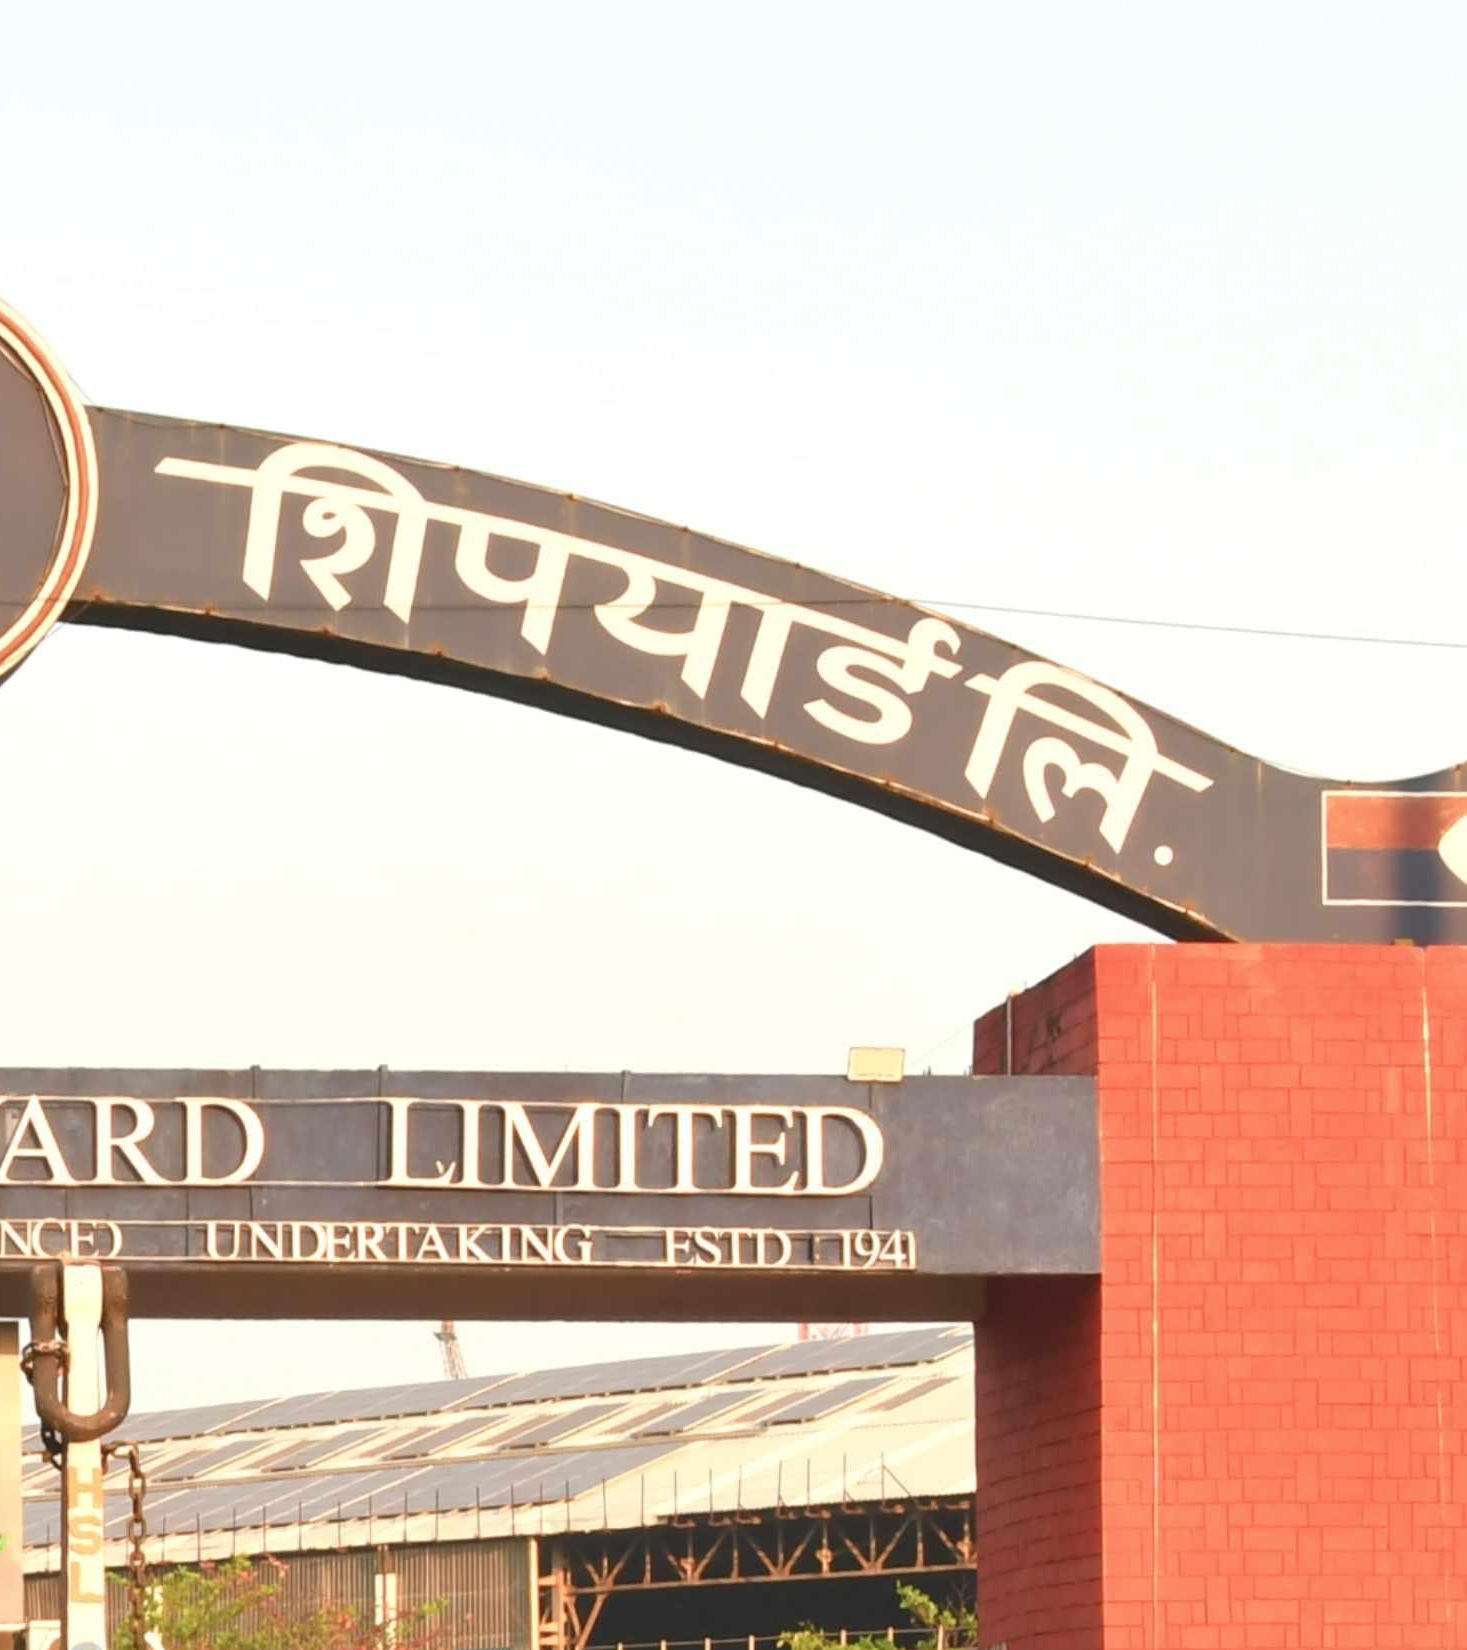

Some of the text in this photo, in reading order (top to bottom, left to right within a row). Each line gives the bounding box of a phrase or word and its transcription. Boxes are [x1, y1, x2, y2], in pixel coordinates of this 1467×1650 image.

[154, 441, 964, 748] शिपयार्ड
[965, 658, 1215, 868] लि.
[381, 1096, 885, 1197] LIMITED
[206, 1220, 595, 1265] UNDERTAKING
[665, 1226, 794, 1268] ESTD
[841, 1229, 917, 1270] 1941
[67, 1465, 105, 1605] HSL
